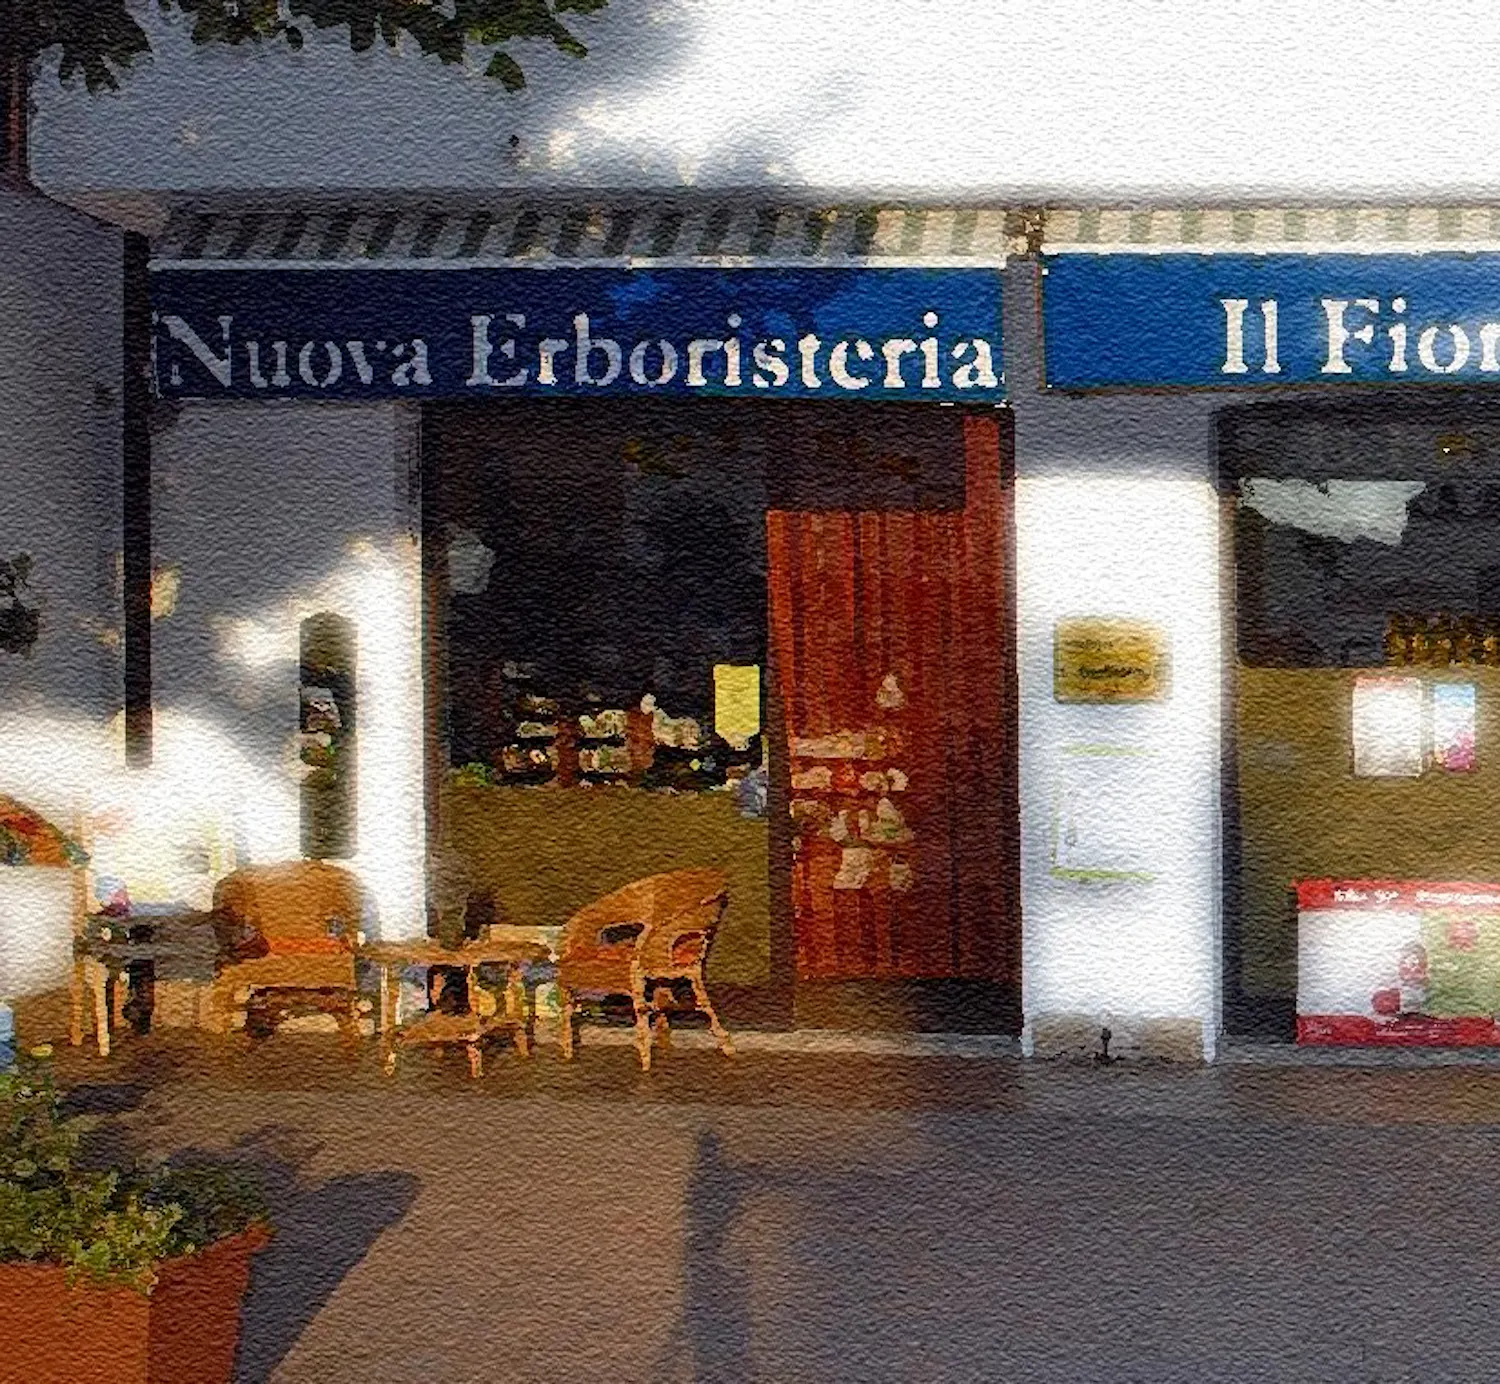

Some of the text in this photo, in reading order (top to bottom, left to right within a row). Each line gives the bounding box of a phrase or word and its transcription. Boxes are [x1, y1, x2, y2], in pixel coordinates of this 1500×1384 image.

[161, 311, 1000, 389] Nuova Erboristeria
[1220, 298, 1281, 375] Il
